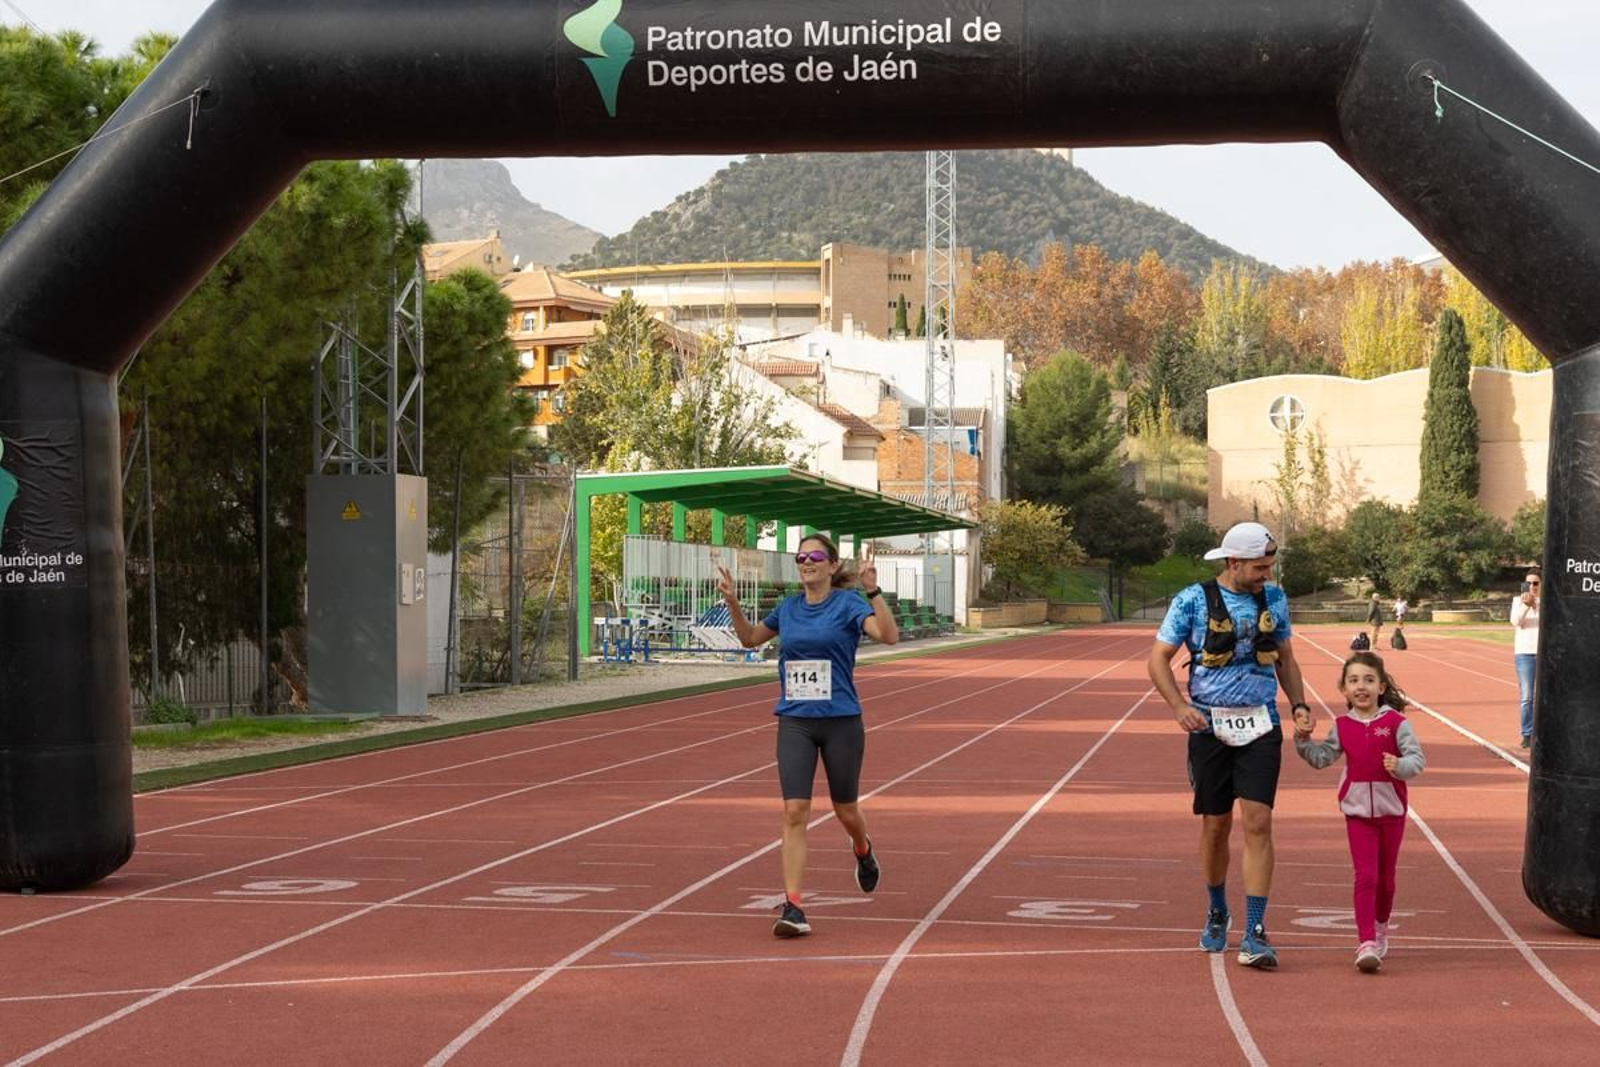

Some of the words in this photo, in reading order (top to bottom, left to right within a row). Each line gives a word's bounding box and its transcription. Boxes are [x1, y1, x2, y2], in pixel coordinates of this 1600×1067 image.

[647, 24, 793, 51] Patronato
[803, 17, 952, 51] Municipal
[963, 16, 1002, 43] de
[647, 59, 786, 93] Deportes
[795, 56, 834, 82] de
[843, 52, 918, 82] Jaén
[0, 552, 61, 569] unicipal
[65, 552, 83, 565] de
[6, 570, 25, 583] de
[29, 568, 65, 583] Jaén
[793, 671, 818, 683] 114
[1225, 716, 1255, 730] 101
